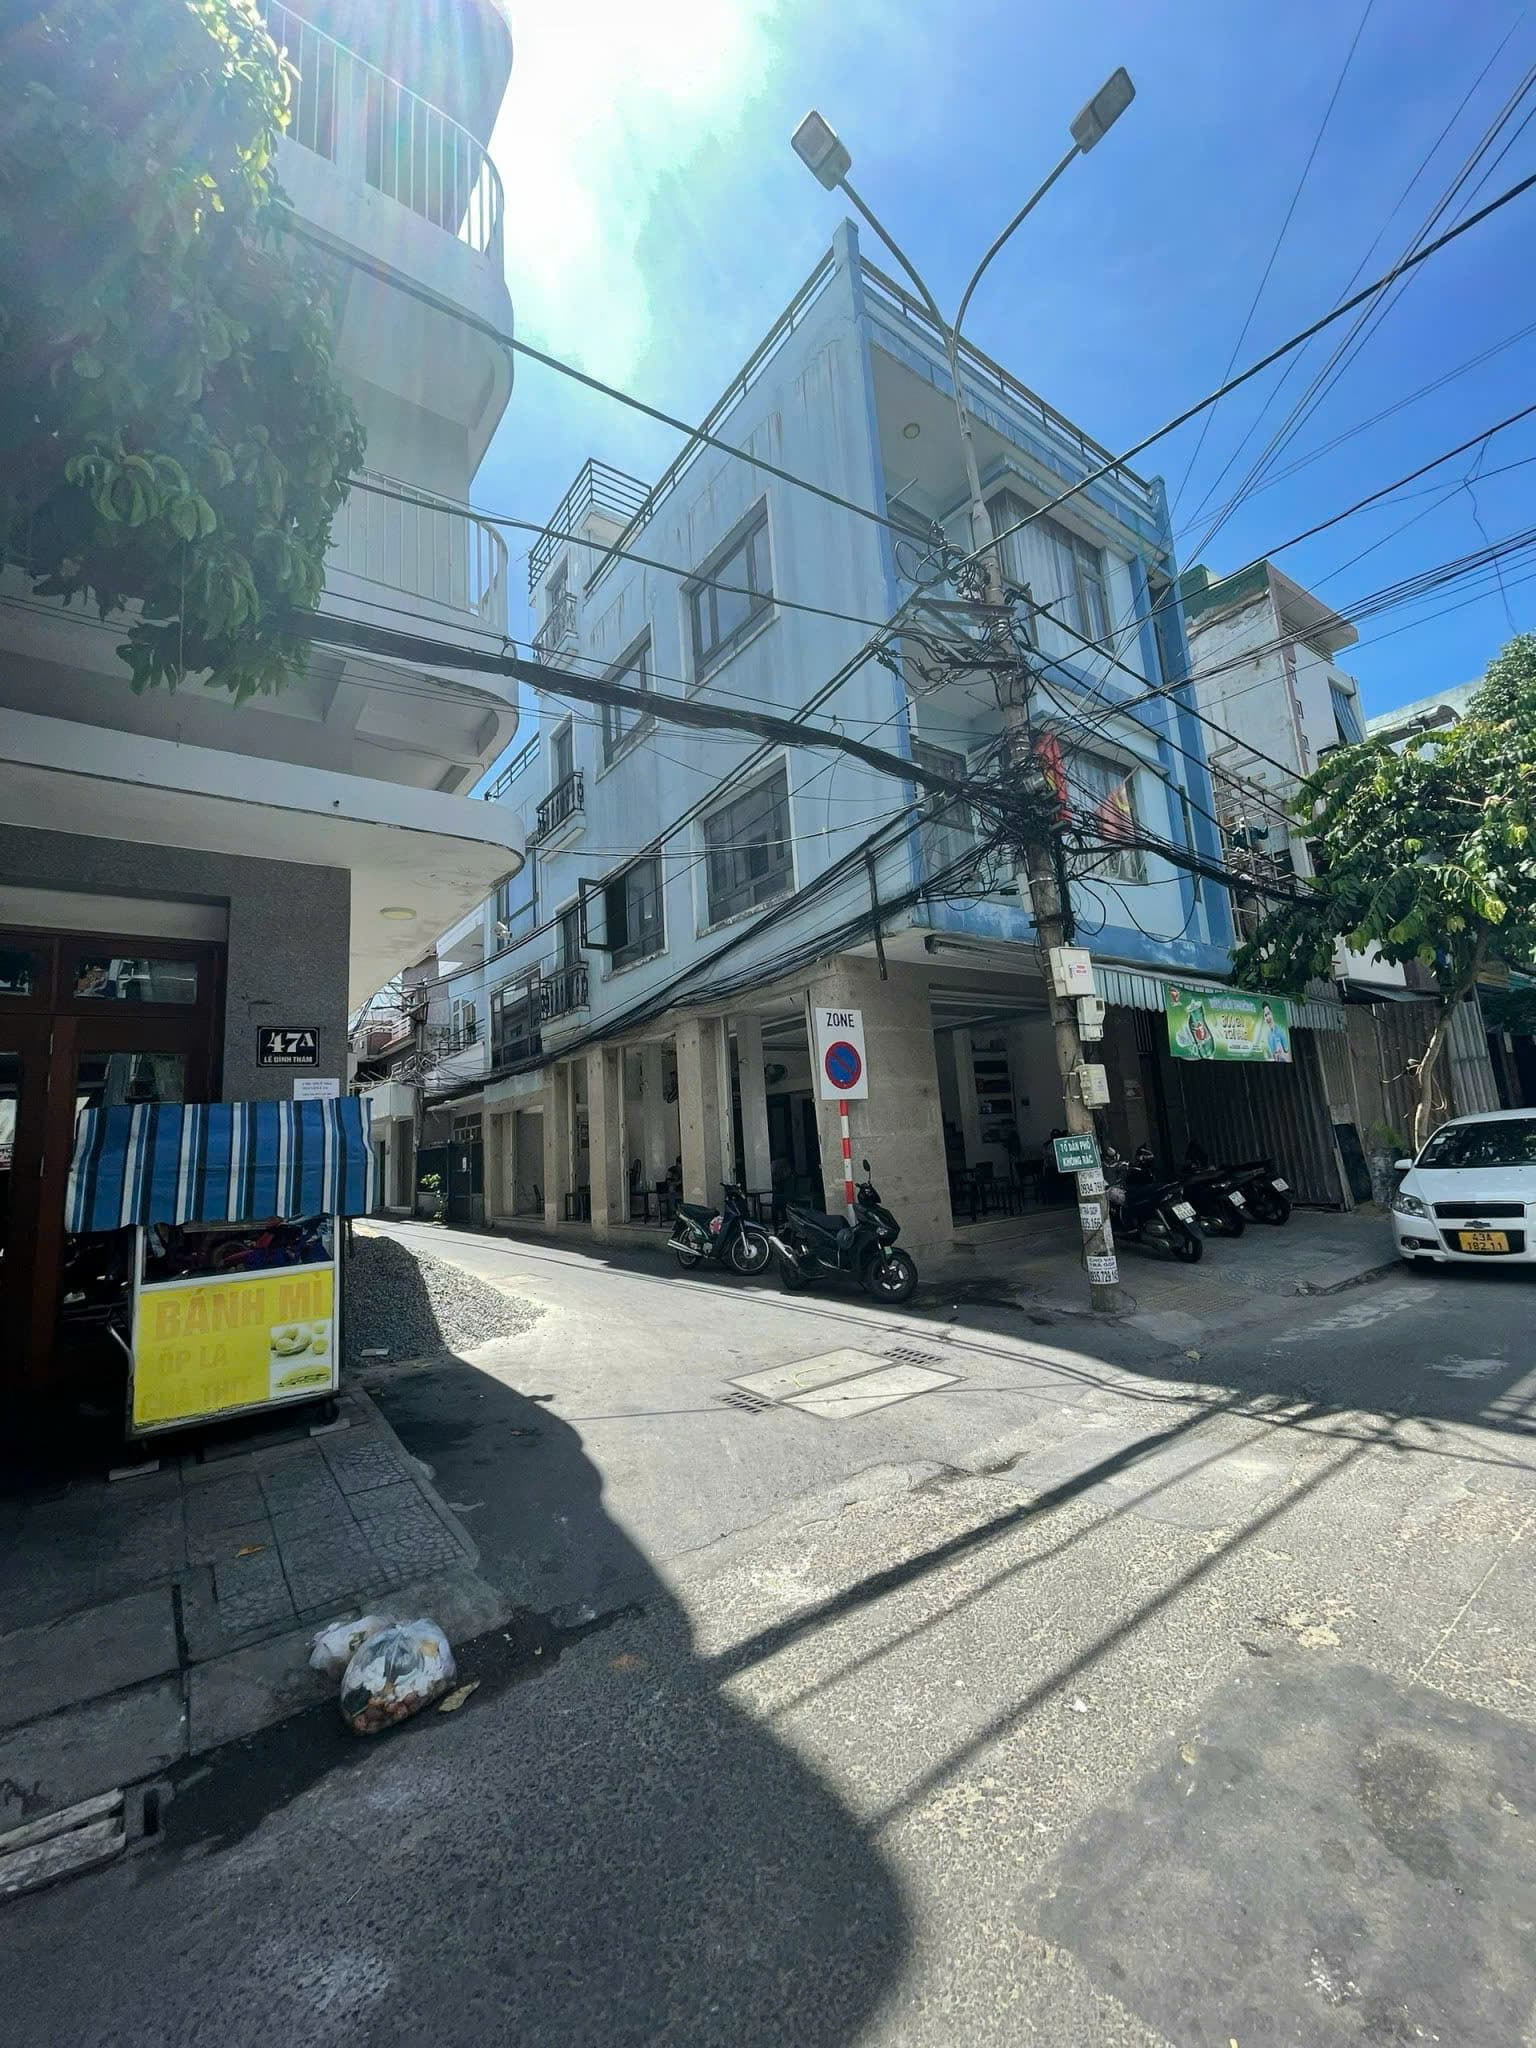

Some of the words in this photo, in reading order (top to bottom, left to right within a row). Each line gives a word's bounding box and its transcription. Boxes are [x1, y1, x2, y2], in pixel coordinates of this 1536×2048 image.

[825, 1012, 855, 1028] ZONE
[266, 1031, 315, 1053] 47A
[1472, 1232, 1493, 1242] 43A
[155, 1287, 265, 1342] BÁNH
[278, 1271, 323, 1321] MÌ
